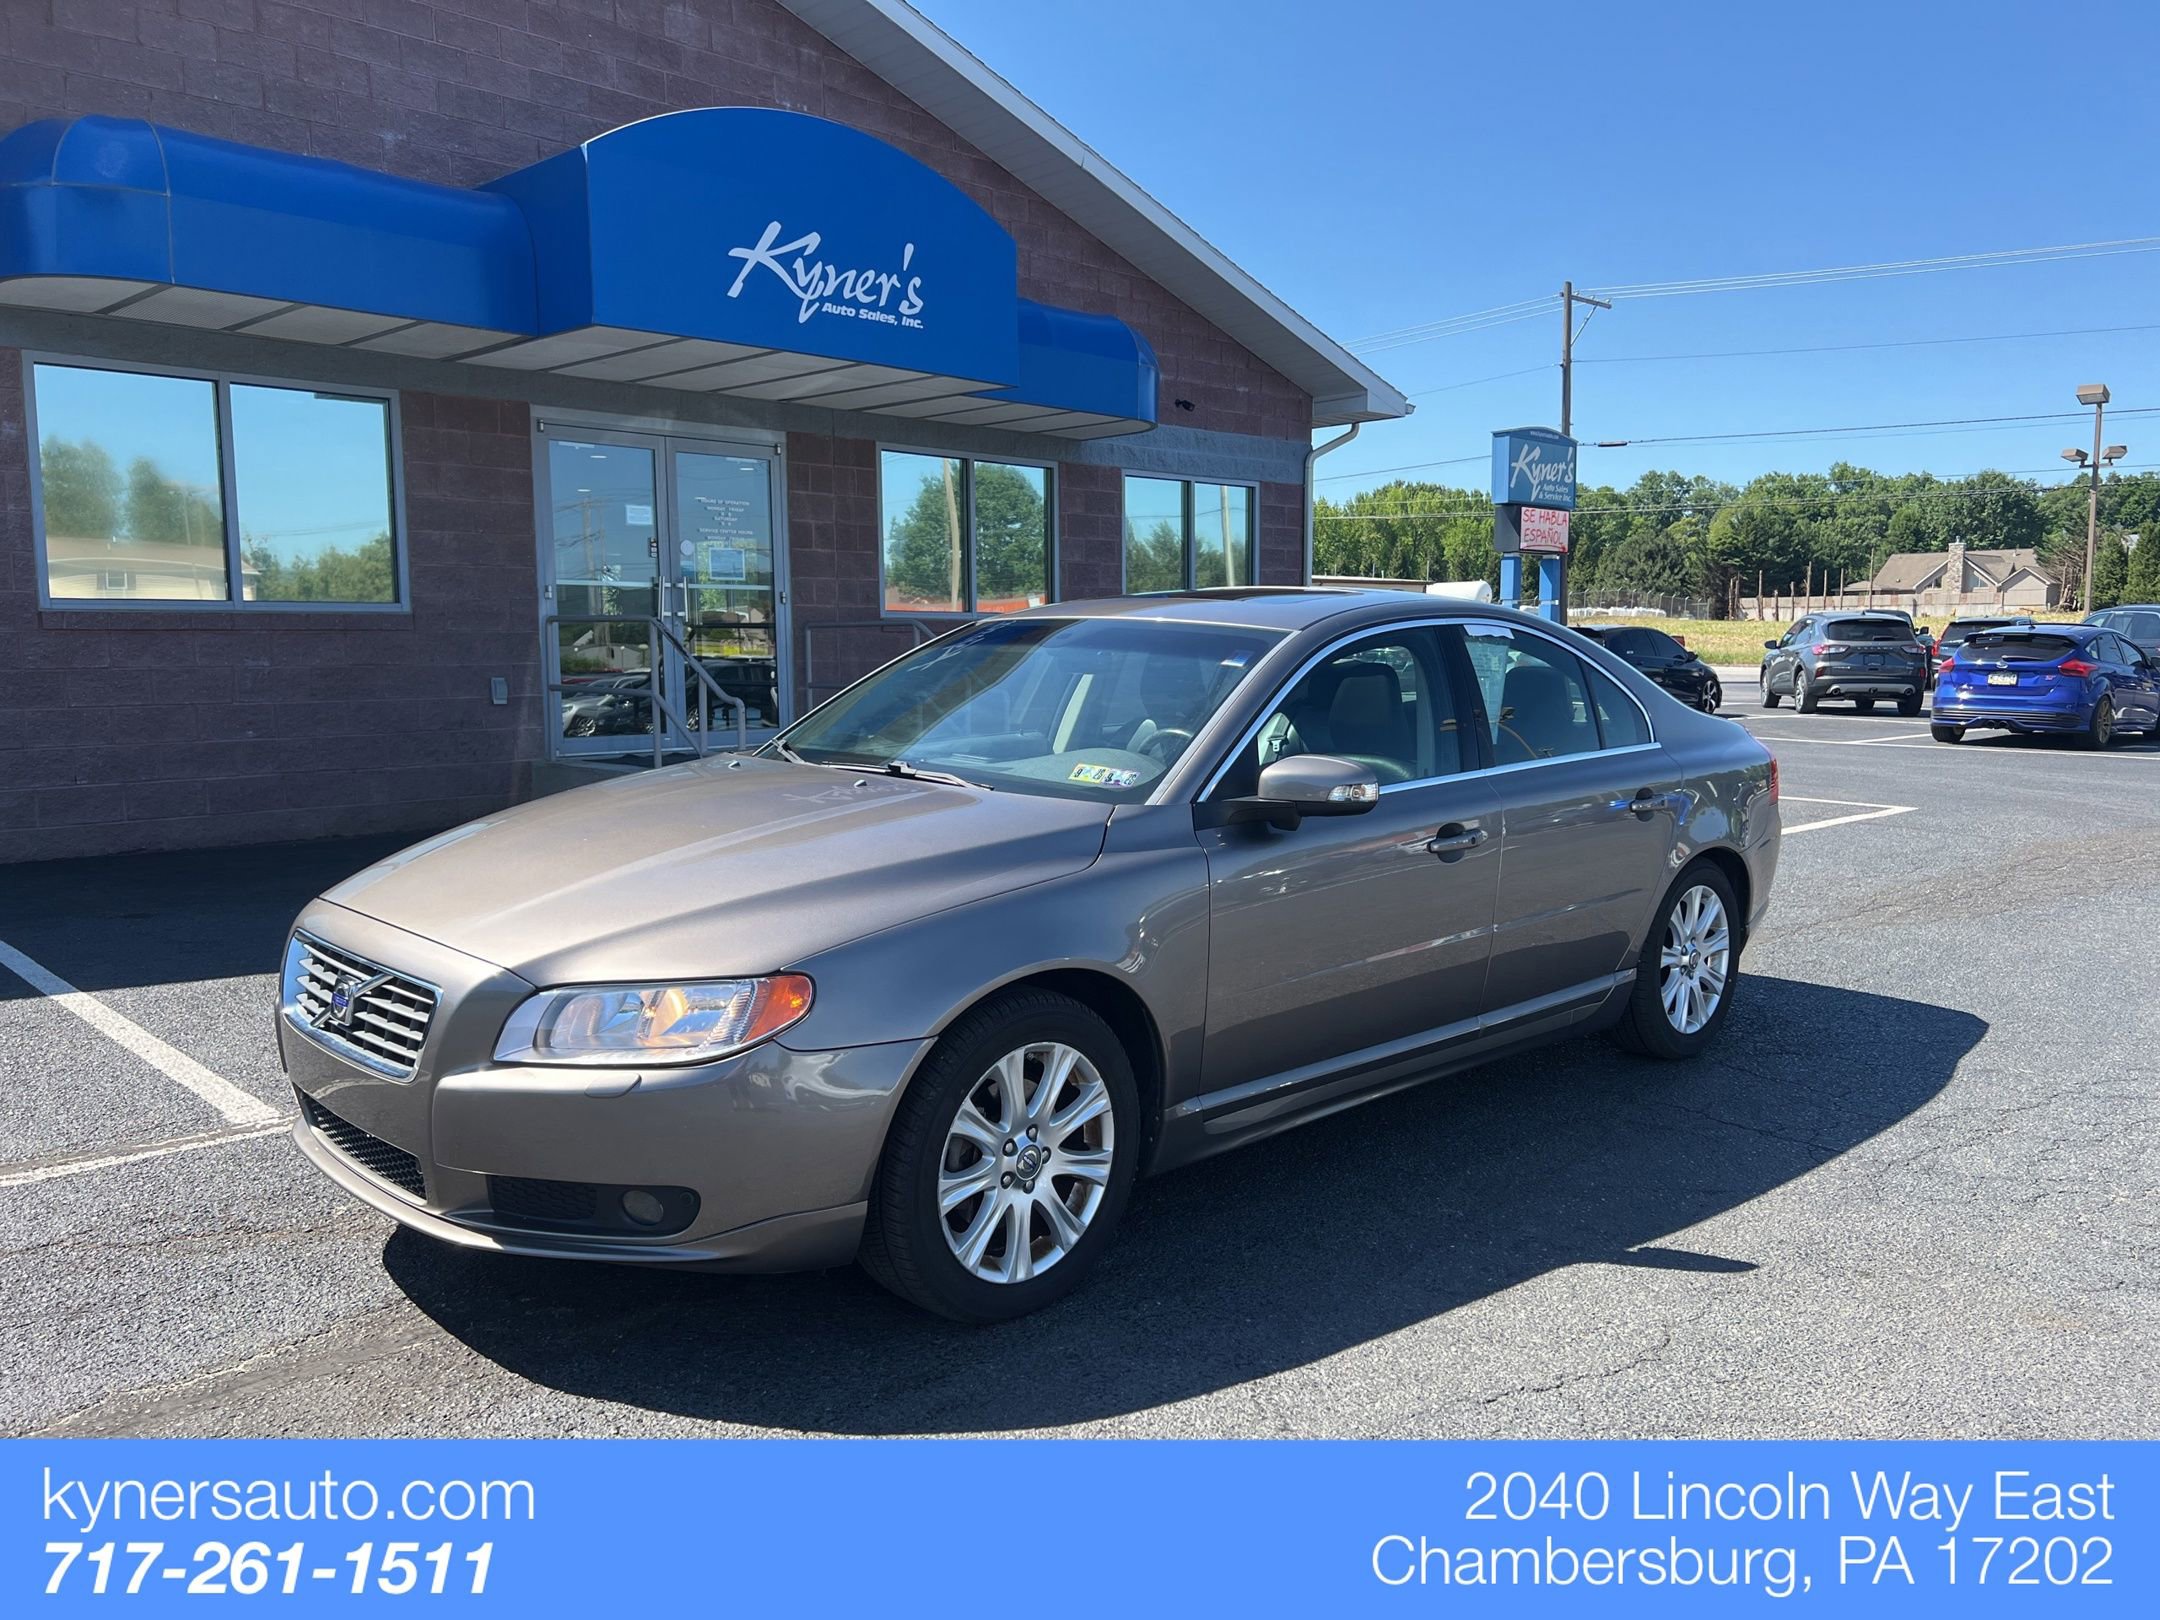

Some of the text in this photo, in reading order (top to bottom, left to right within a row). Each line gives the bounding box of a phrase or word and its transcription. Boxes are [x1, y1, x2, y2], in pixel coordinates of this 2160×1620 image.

[727, 220, 924, 324] Kyner's
[821, 302, 924, 329] Auto Sales, Inc.
[1510, 443, 1574, 502] Kyner's
[1543, 483, 1569, 493] Auto Sales
[1522, 509, 1568, 527] SE HABLA
[1523, 527, 1564, 545] ESPAÑOL
